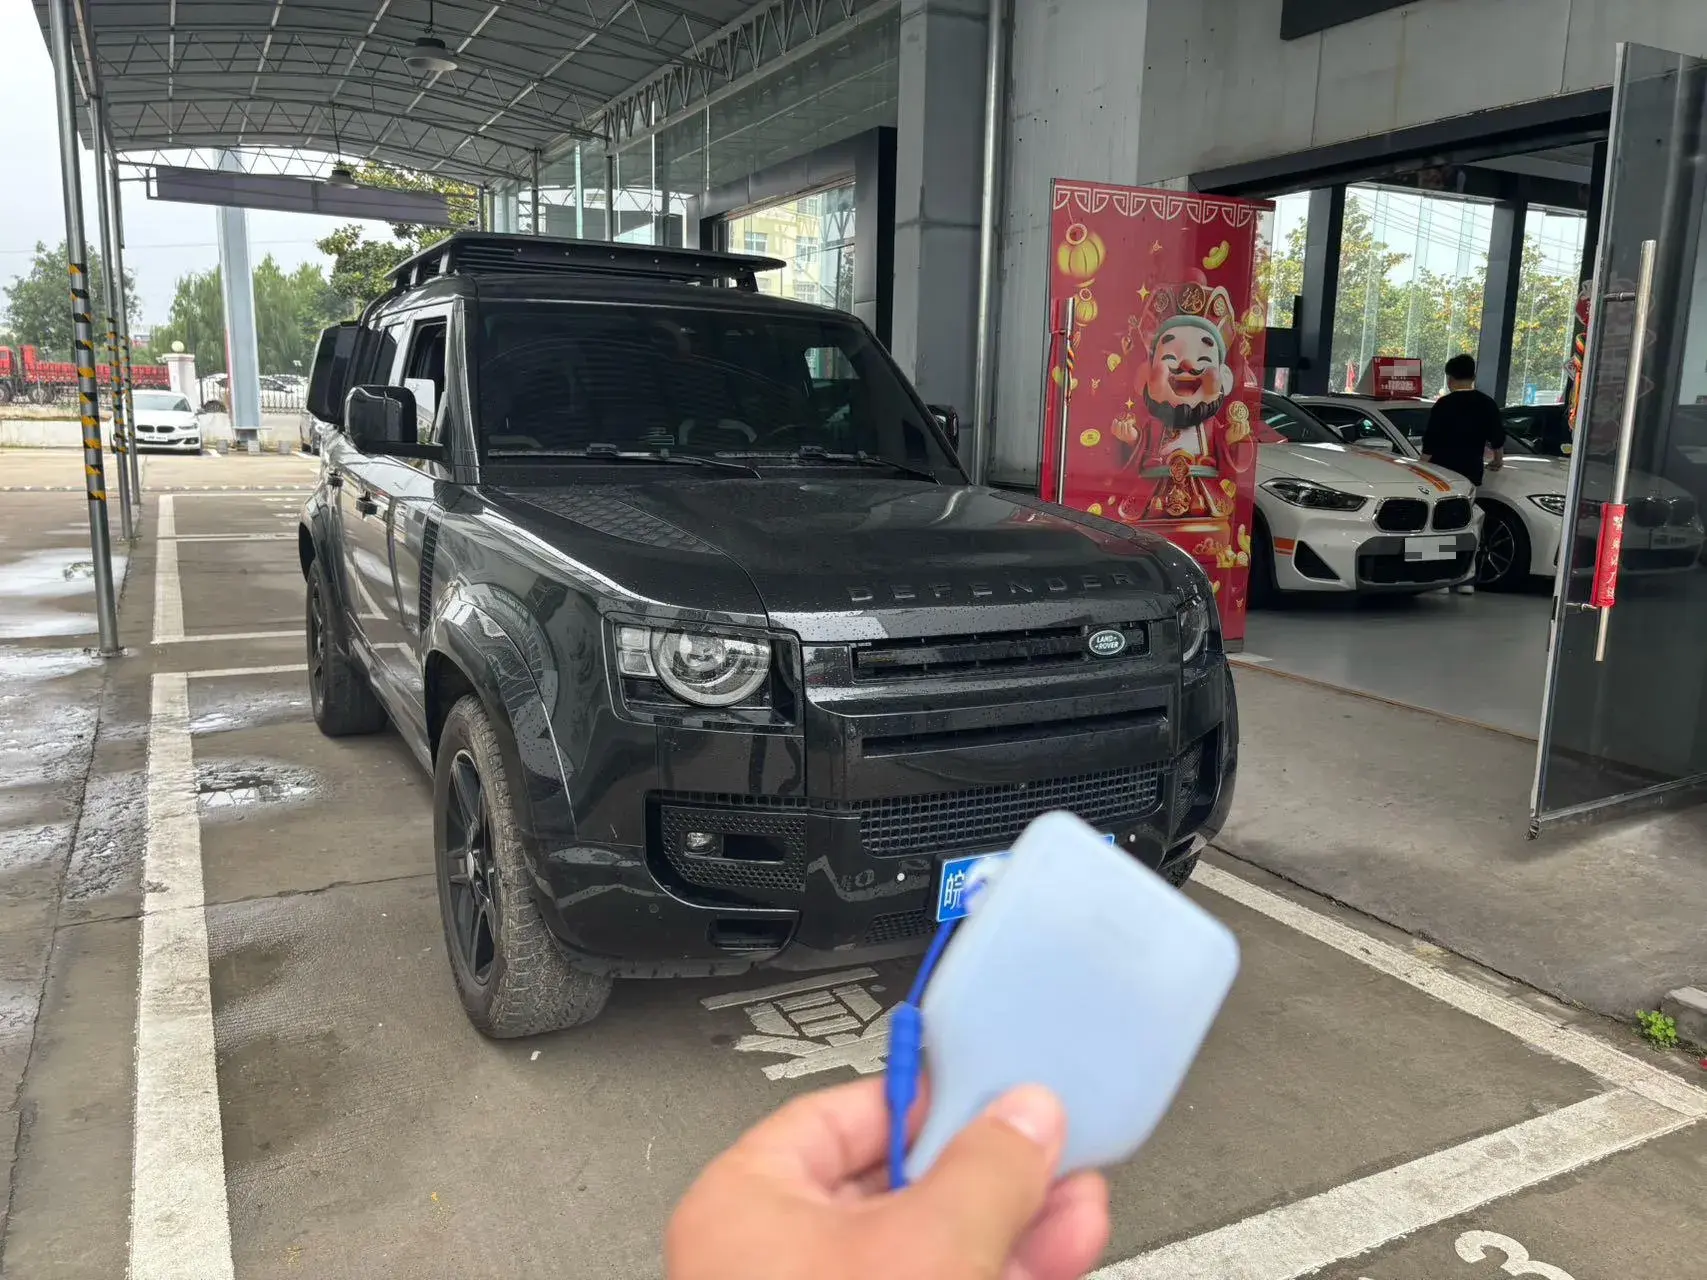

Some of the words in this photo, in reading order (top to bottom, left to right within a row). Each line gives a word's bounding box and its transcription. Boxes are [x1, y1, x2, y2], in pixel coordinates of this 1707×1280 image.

[847, 573, 1134, 601] DEFENDER
[1096, 634, 1114, 643] LAND
[1098, 641, 1119, 650] ROVER
